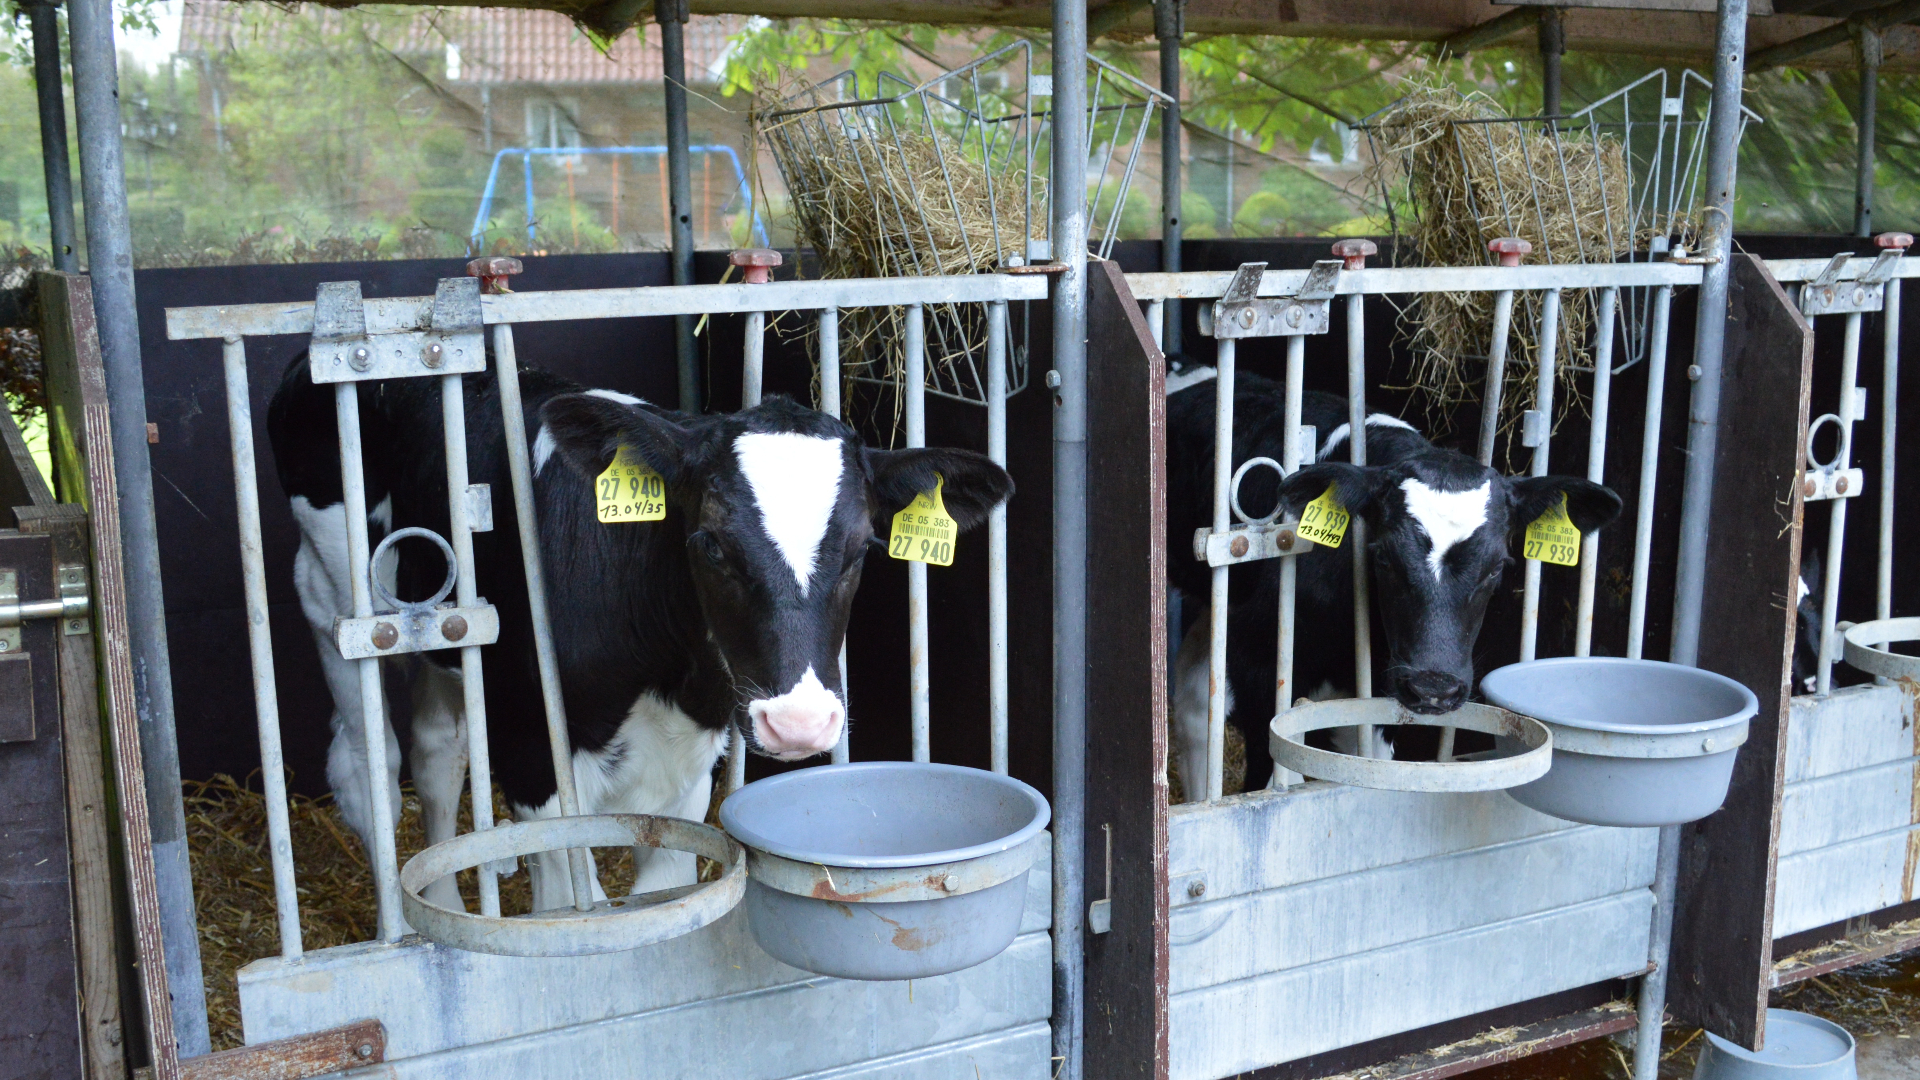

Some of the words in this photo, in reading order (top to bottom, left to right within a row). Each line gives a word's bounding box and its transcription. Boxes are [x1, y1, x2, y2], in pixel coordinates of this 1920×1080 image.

[611, 468, 619, 476] DE
[601, 478, 620, 500] 27
[630, 476, 661, 499] 940
[600, 499, 664, 518] 13.04/35
[1305, 505, 1323, 523] 27
[1324, 511, 1347, 531] 939
[903, 513, 914, 523] DE
[918, 515, 929, 525] 05
[934, 518, 950, 528] 383
[1534, 522, 1543, 531] DE
[1547, 525, 1556, 533] 05
[1560, 527, 1574, 535] 383
[892, 535, 913, 557] 27
[921, 539, 951, 563] 940
[1526, 540, 1543, 558] 27
[1550, 543, 1575, 563] 939
